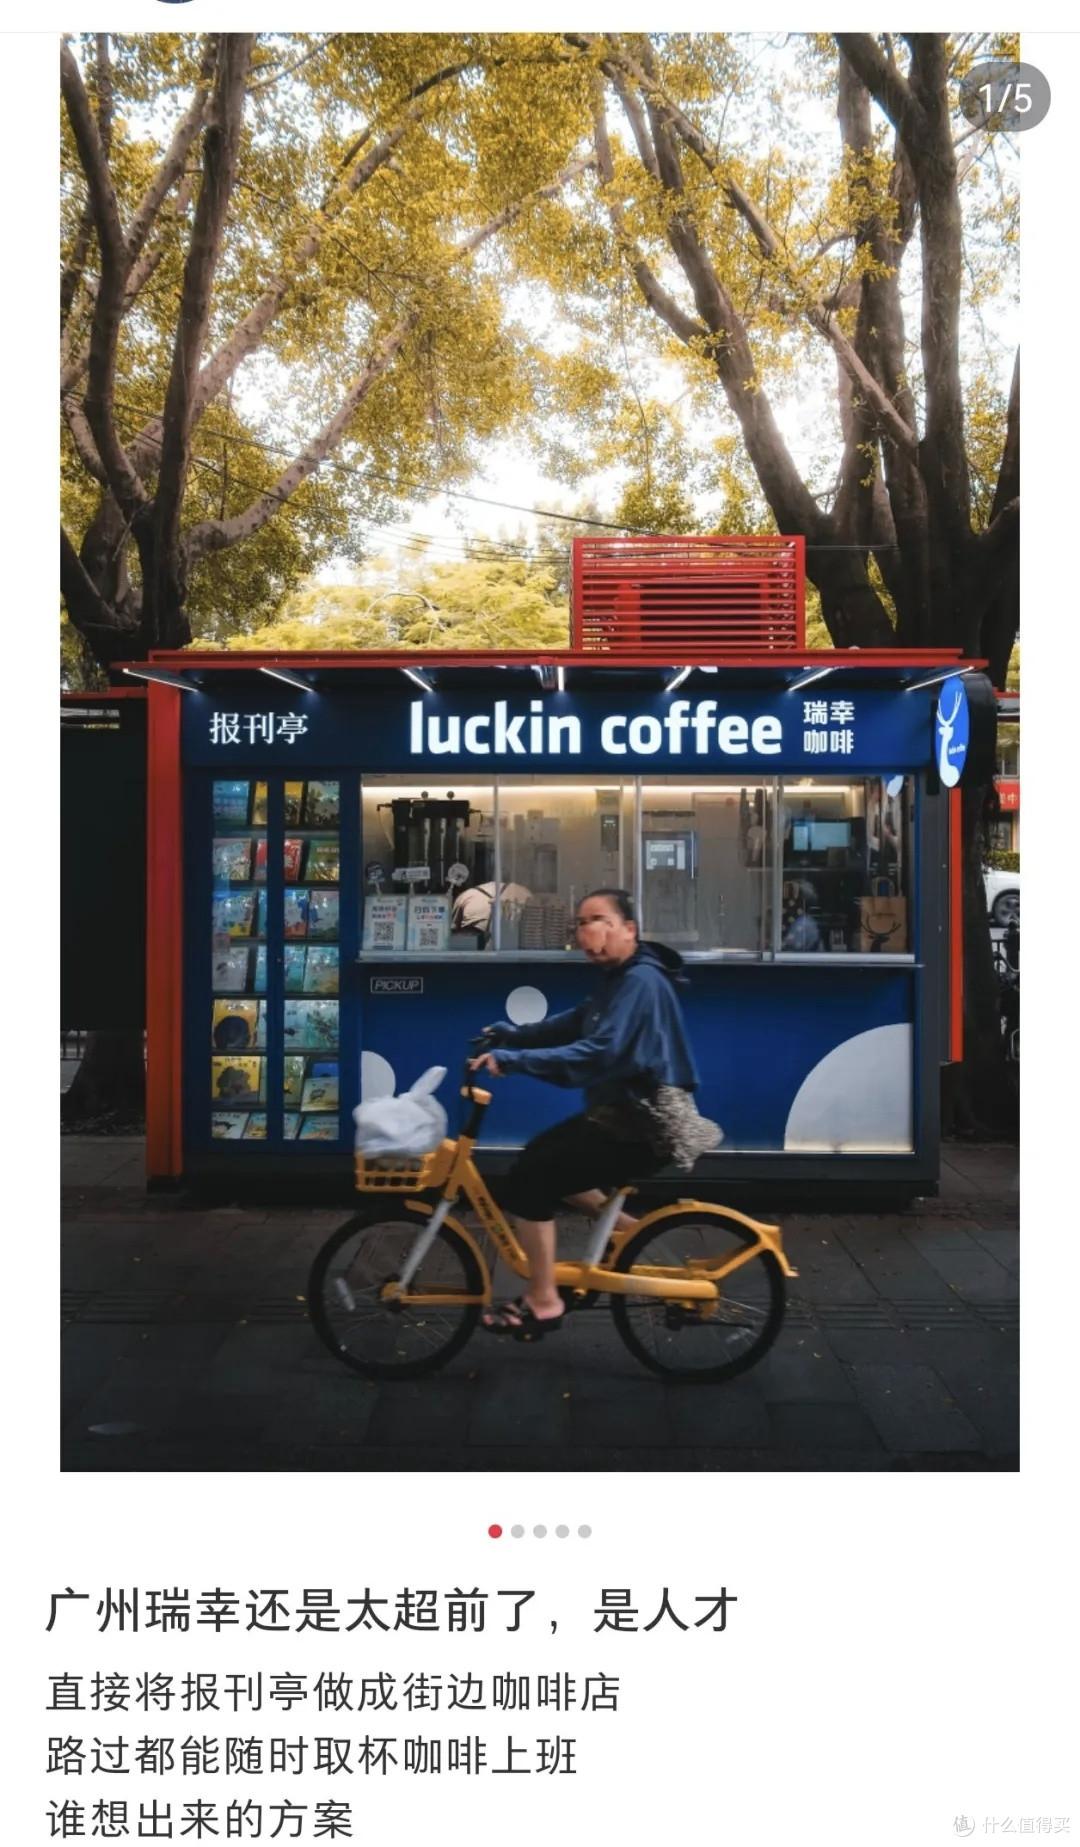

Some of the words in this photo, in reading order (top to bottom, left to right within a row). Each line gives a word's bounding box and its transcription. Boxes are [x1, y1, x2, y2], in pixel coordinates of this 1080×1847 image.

[803, 700, 855, 725] 瑞幸
[209, 711, 309, 745] 报刊亭
[410, 700, 581, 755] luckin
[600, 700, 783, 755] coffee
[803, 729, 854, 754] 咖啡
[374, 980, 420, 990] PICKUP
